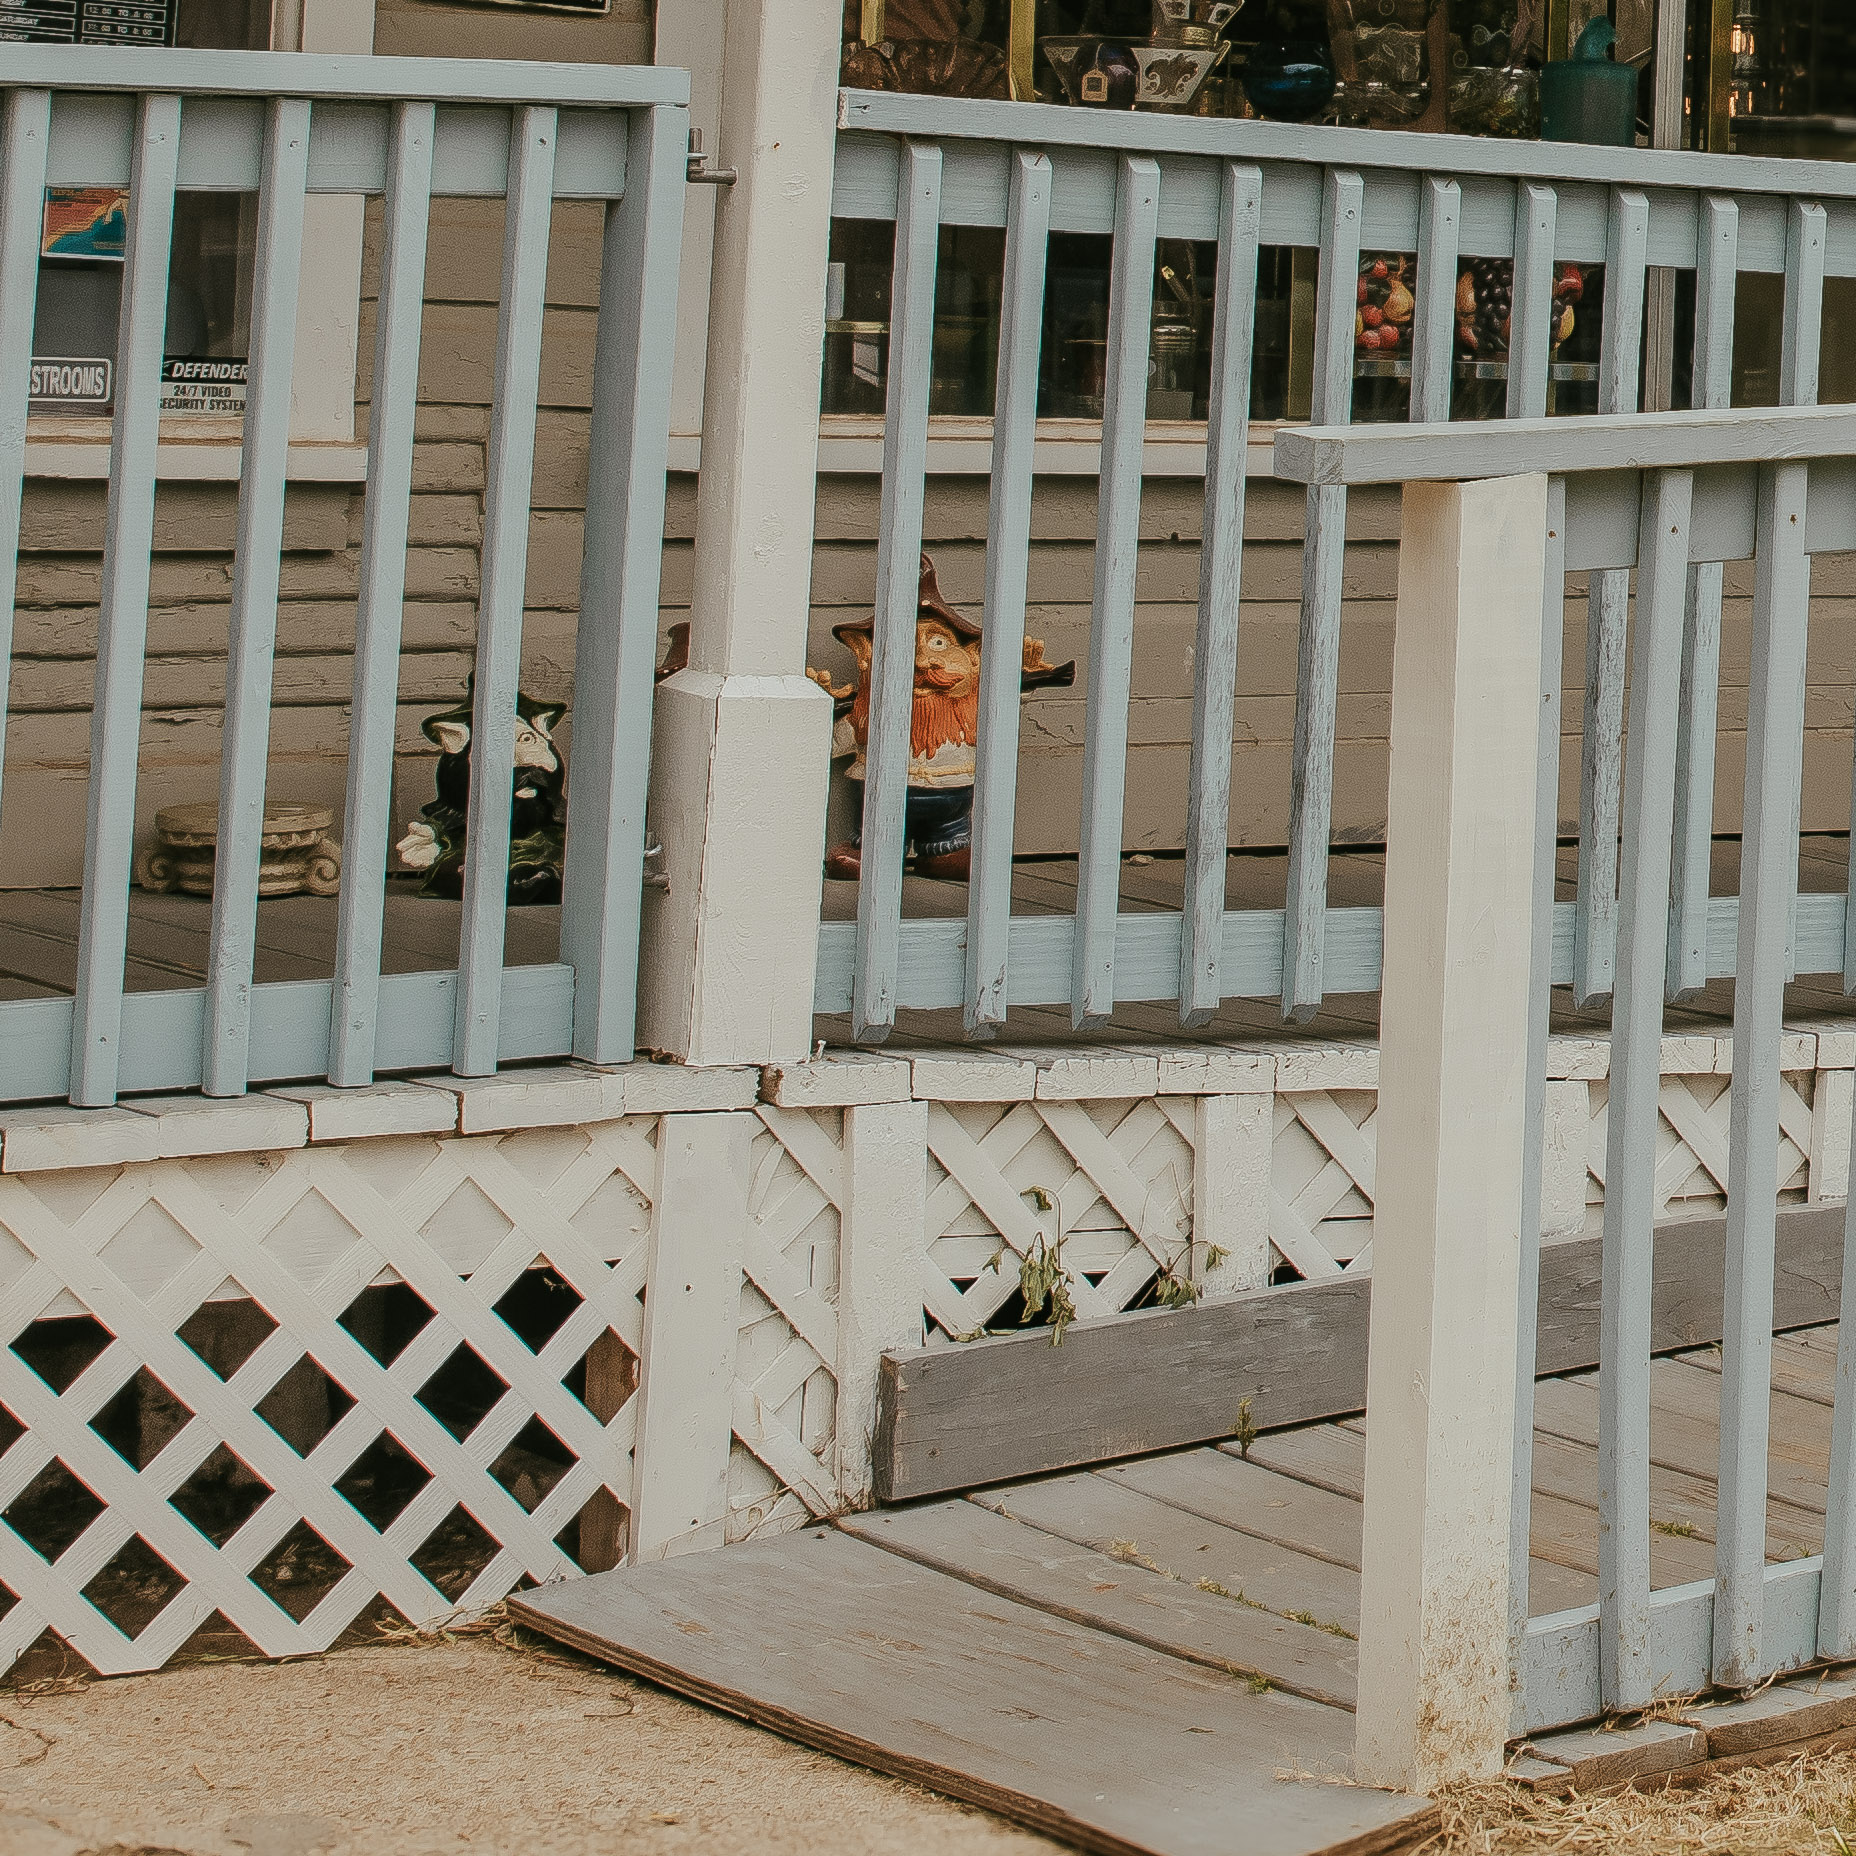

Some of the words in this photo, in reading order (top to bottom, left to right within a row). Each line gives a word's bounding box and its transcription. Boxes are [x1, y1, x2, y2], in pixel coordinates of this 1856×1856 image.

[171, 362, 249, 380] DEFENDER
[31, 365, 105, 395] STROOMS
[174, 386, 198, 398] 24/7
[200, 386, 231, 398] VIDEO
[160, 398, 206, 410] ECURITY
